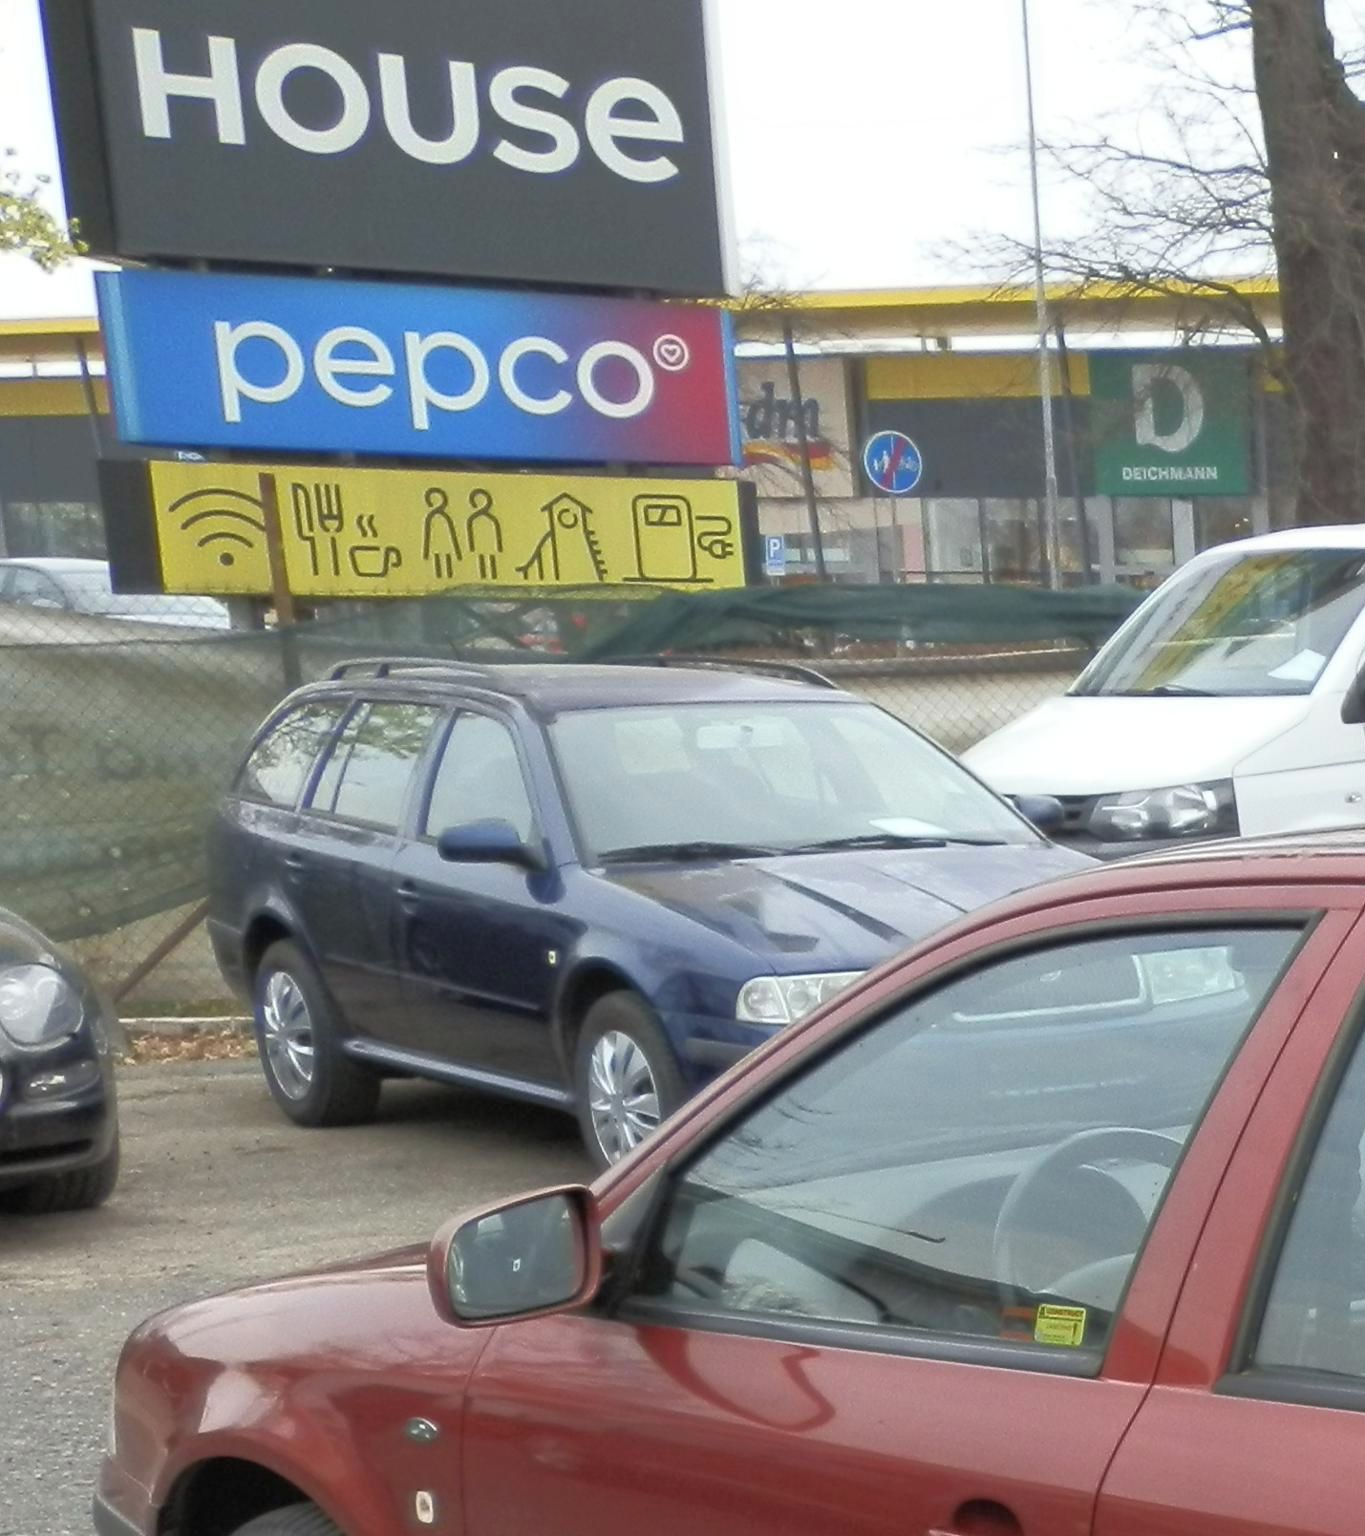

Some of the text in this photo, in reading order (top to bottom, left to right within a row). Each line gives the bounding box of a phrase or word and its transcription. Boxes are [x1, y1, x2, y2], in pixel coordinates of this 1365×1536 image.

[213, 320, 655, 431] pepco
[1121, 466, 1219, 481] DEICHMANN
[769, 538, 781, 558] P
